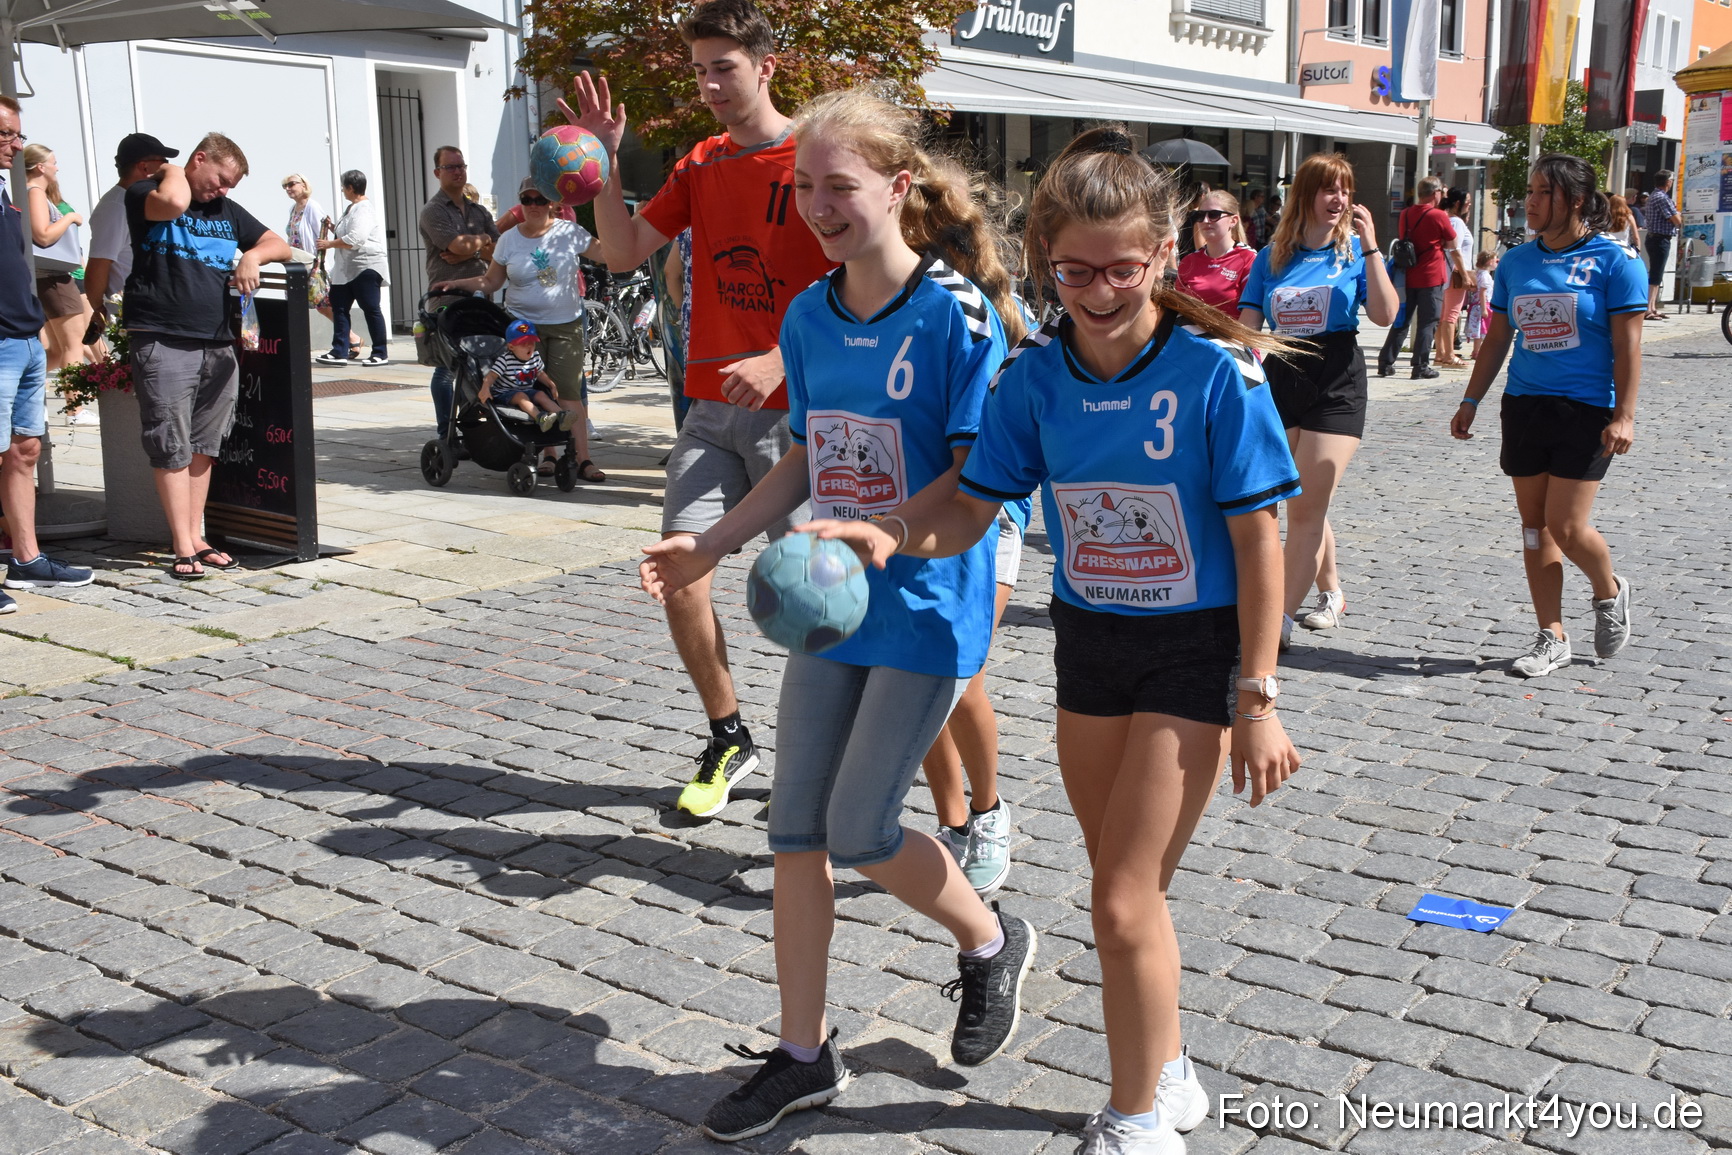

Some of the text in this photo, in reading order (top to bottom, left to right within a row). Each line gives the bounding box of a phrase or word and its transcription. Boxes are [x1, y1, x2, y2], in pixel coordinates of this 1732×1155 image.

[766, 181, 793, 226] 11
[1565, 256, 1597, 286] 13
[1524, 325, 1570, 337] RESSNAPF
[844, 334, 879, 348] hummel
[886, 335, 914, 401] 6
[1083, 396, 1131, 412] hummel
[1143, 389, 1178, 460] 3
[820, 478, 893, 498] FRESAPF
[1077, 553, 1178, 571] FRESSNAPF
[1085, 585, 1173, 602] NEUMARKT
